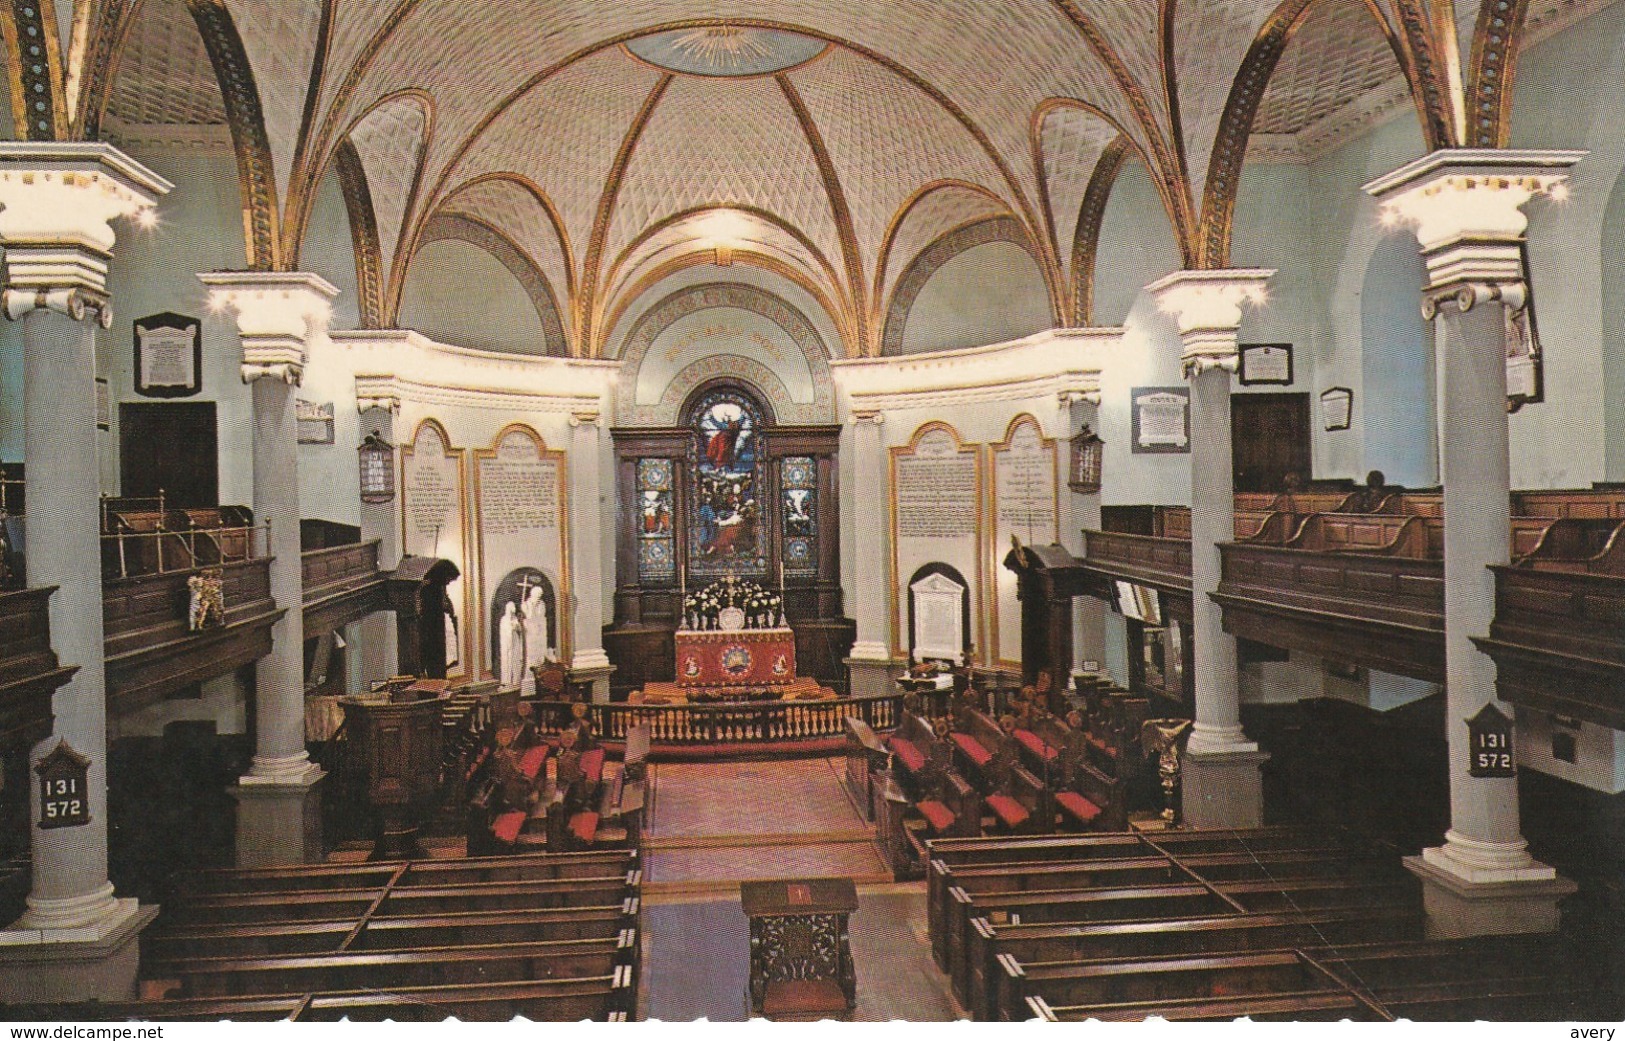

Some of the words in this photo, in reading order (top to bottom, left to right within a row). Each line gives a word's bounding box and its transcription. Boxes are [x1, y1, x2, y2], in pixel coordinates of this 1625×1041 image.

[1479, 733, 1506, 748] 131
[1478, 753, 1511, 768] 572
[46, 778, 76, 796] 131
[46, 799, 81, 818] 572
